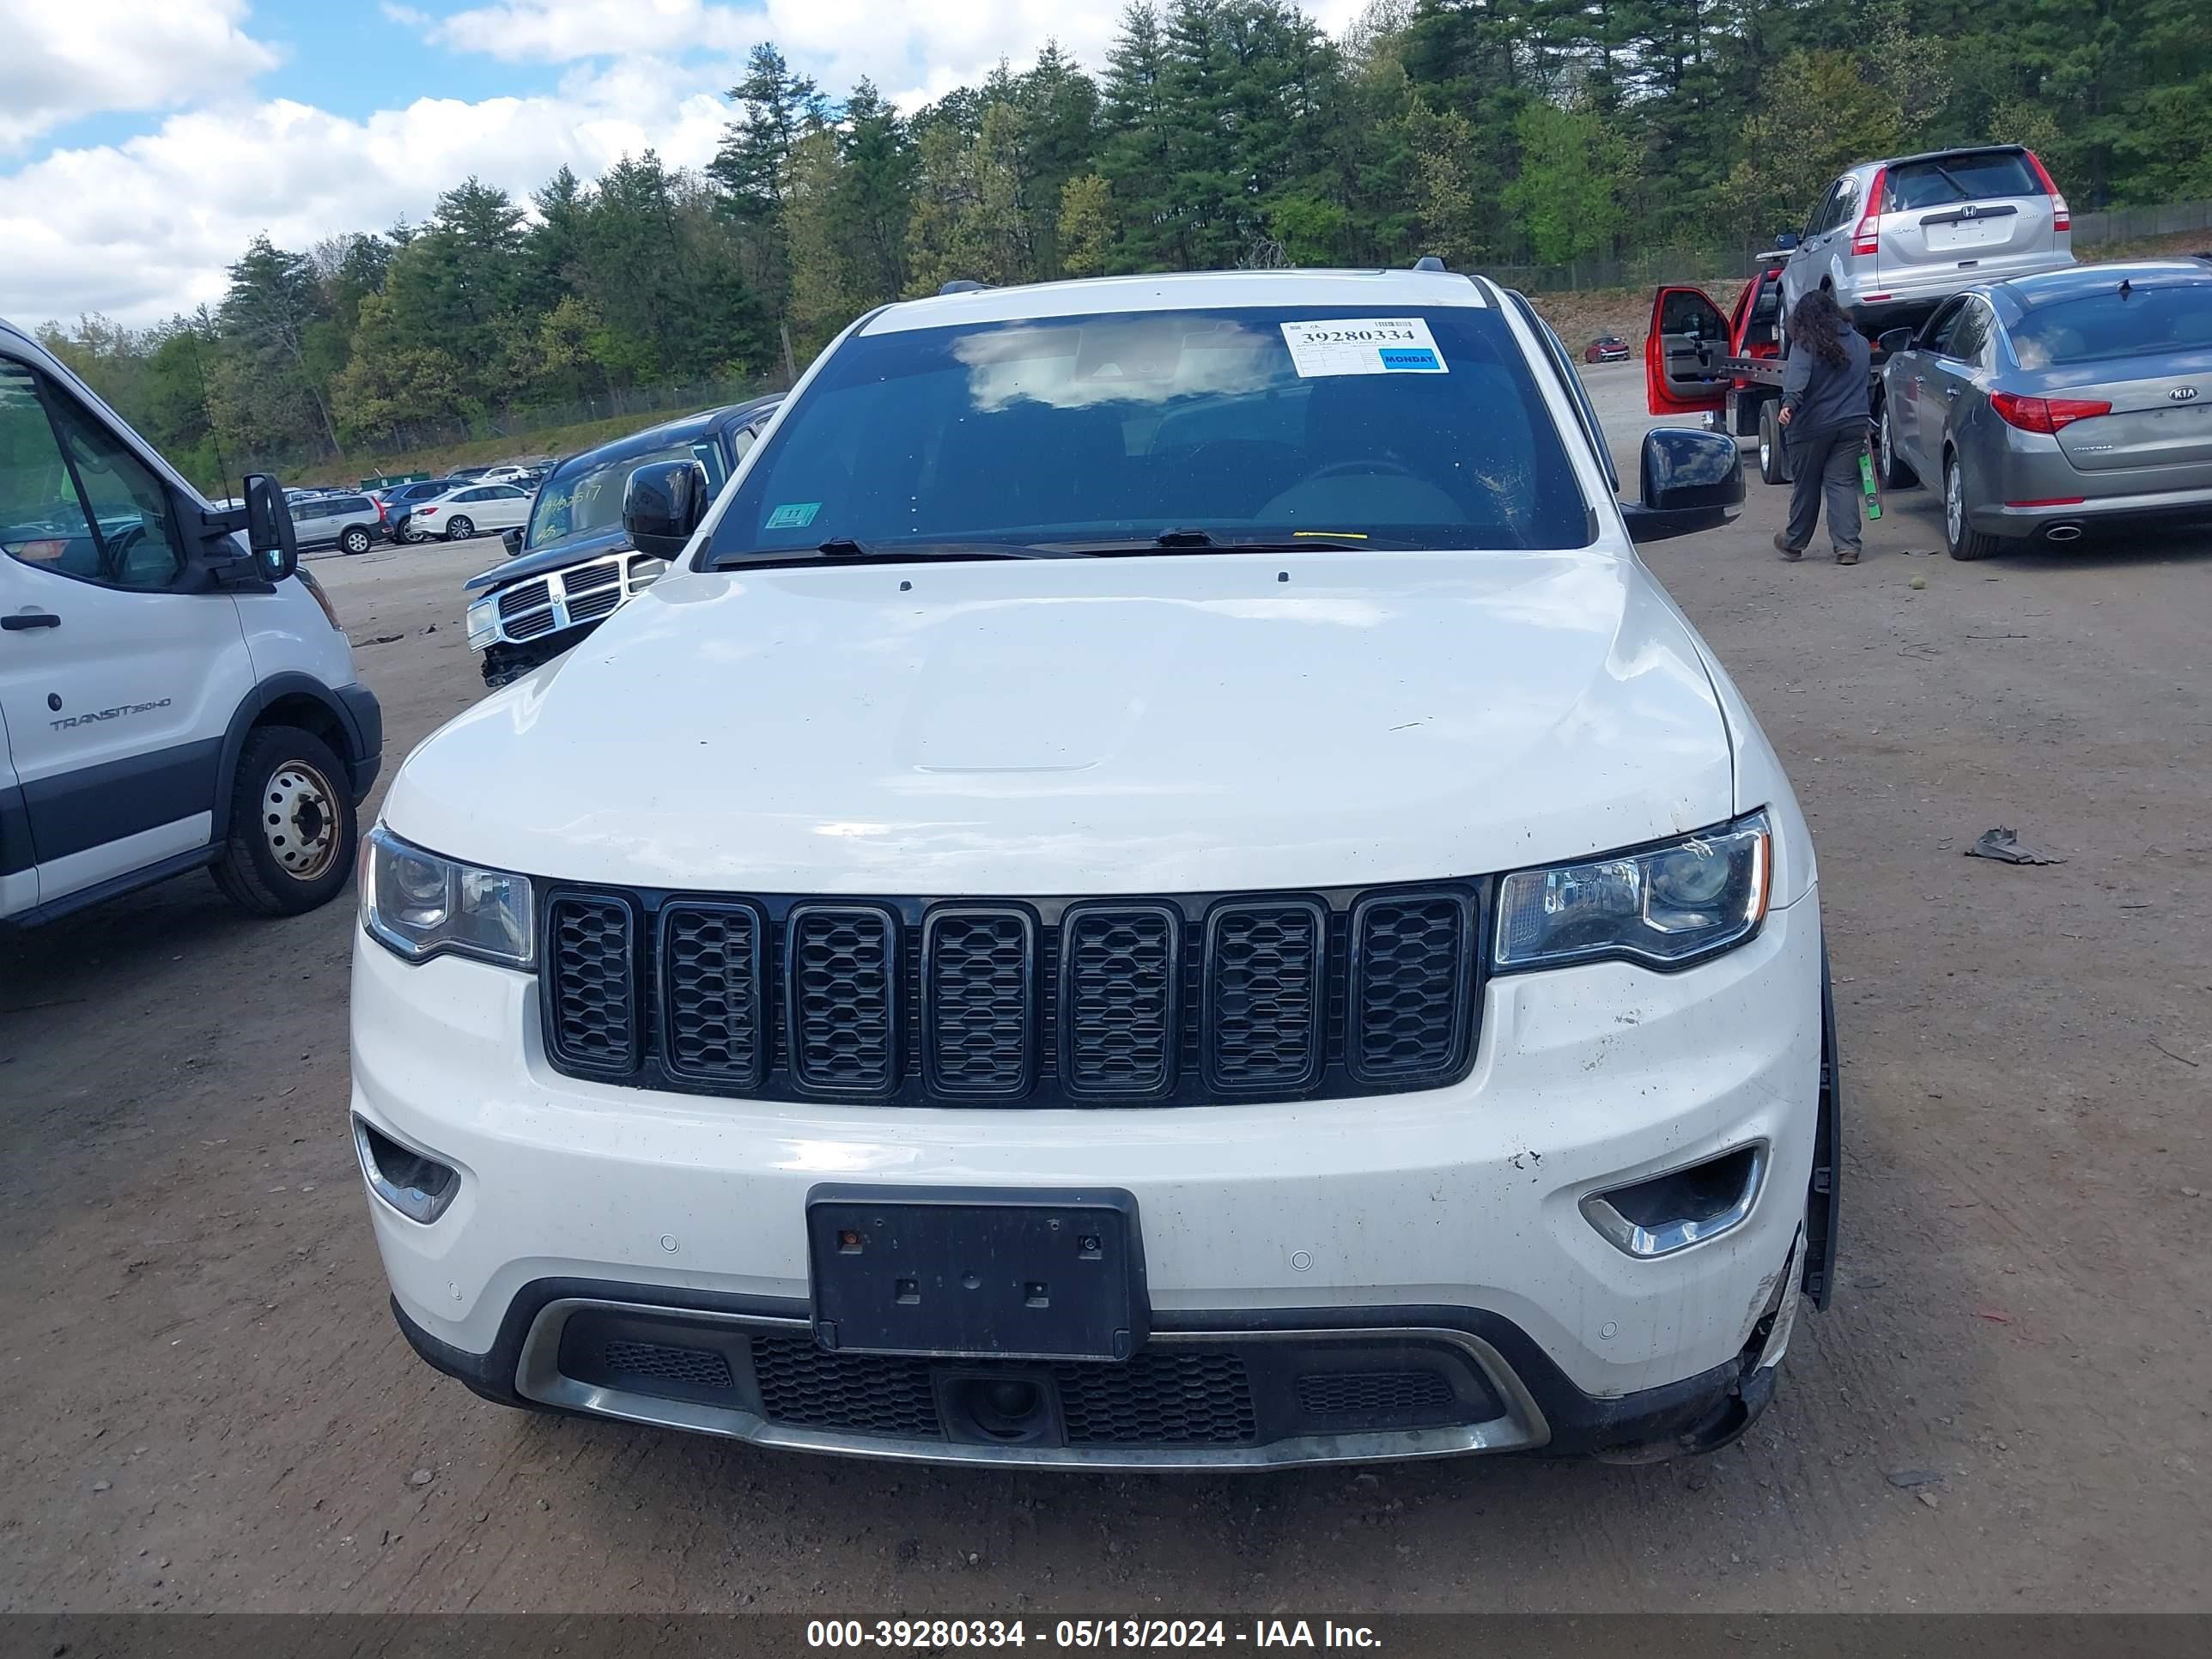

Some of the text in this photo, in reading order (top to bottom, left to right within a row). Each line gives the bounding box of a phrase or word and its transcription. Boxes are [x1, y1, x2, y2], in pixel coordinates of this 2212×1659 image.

[1302, 330, 1415, 343] 39280334
[1385, 356, 1434, 364] MONDAY
[2174, 389, 2195, 398] KIA
[50, 697, 172, 731] TRANSIT 350HD
